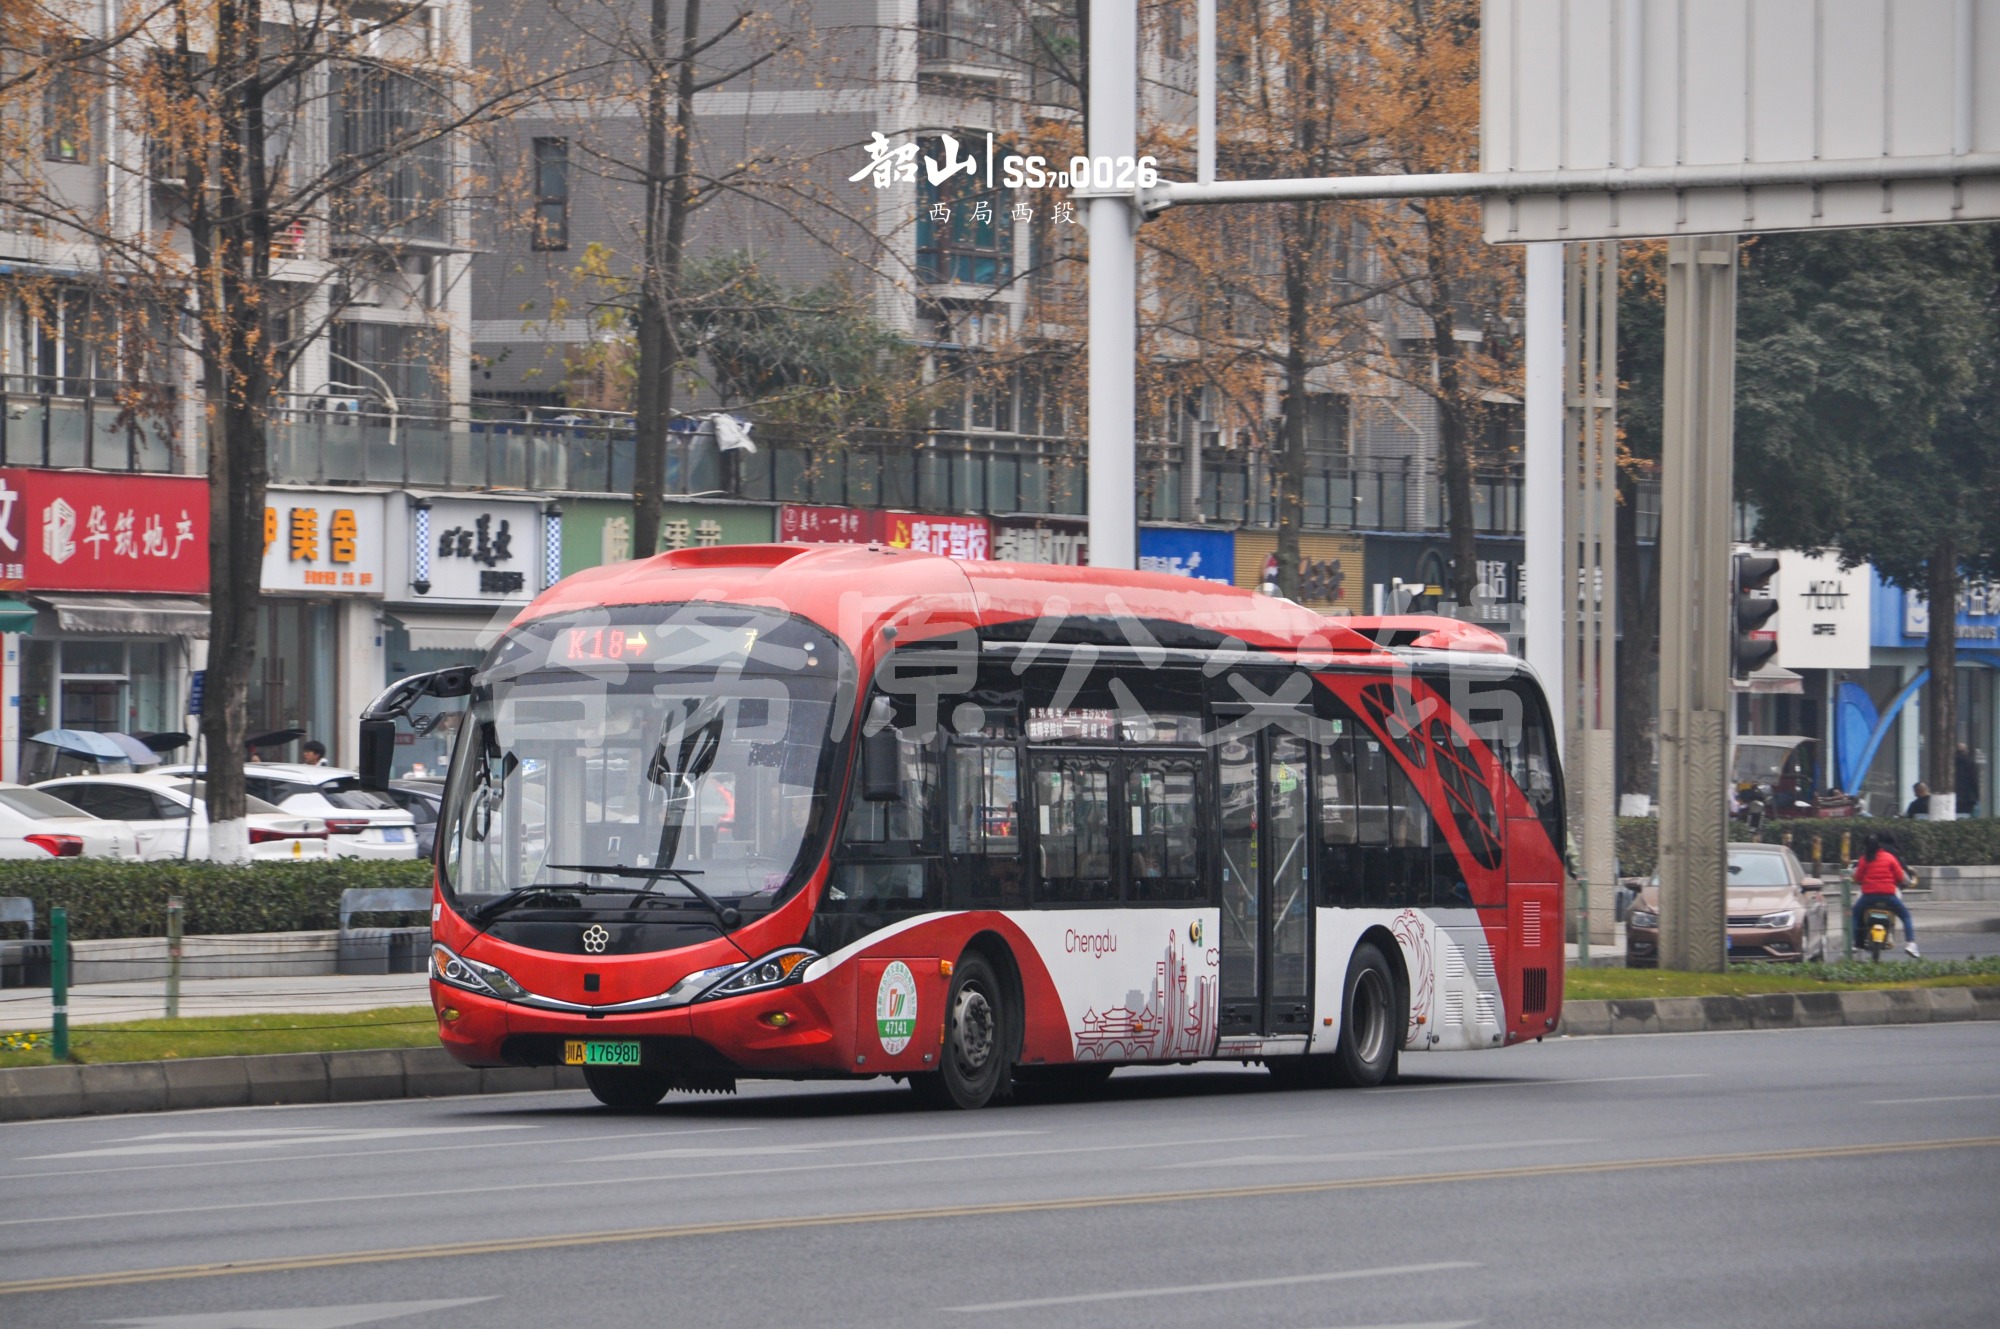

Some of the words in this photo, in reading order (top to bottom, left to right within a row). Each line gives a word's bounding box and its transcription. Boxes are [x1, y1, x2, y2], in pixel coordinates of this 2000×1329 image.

[83, 505, 194, 560] 华筑地产
[568, 629, 625, 660] K18
[1065, 929, 1117, 959] Chengdu
[885, 1020, 907, 1035] 47141
[567, 1044, 639, 1062] 川A17698D
